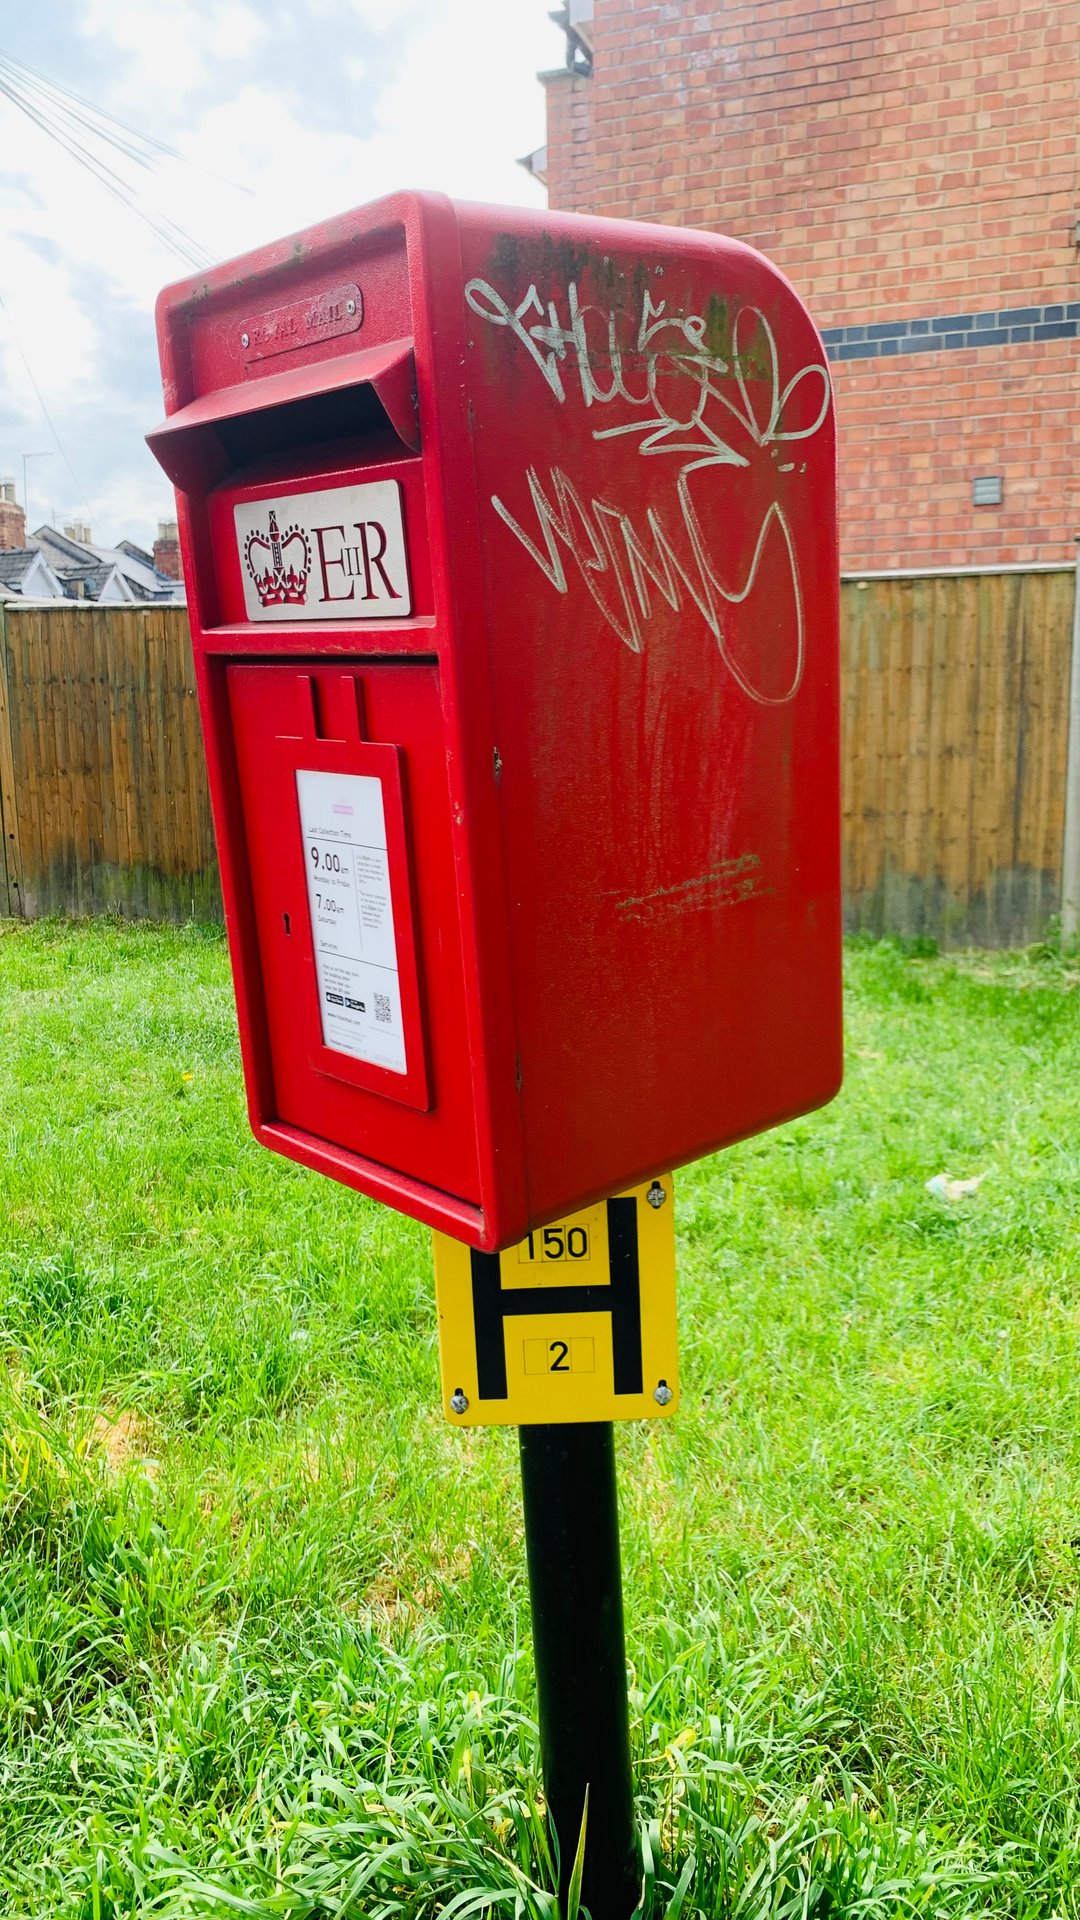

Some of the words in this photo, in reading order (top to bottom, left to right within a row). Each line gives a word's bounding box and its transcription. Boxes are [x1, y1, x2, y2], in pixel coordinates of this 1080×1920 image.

[340, 829, 352, 838] Time
[314, 875, 330, 885] Monday
[336, 878, 350, 888] Friday
[318, 914, 336, 927] Saturday
[525, 1227, 588, 1260] 150
[549, 1341, 570, 1371] 2
